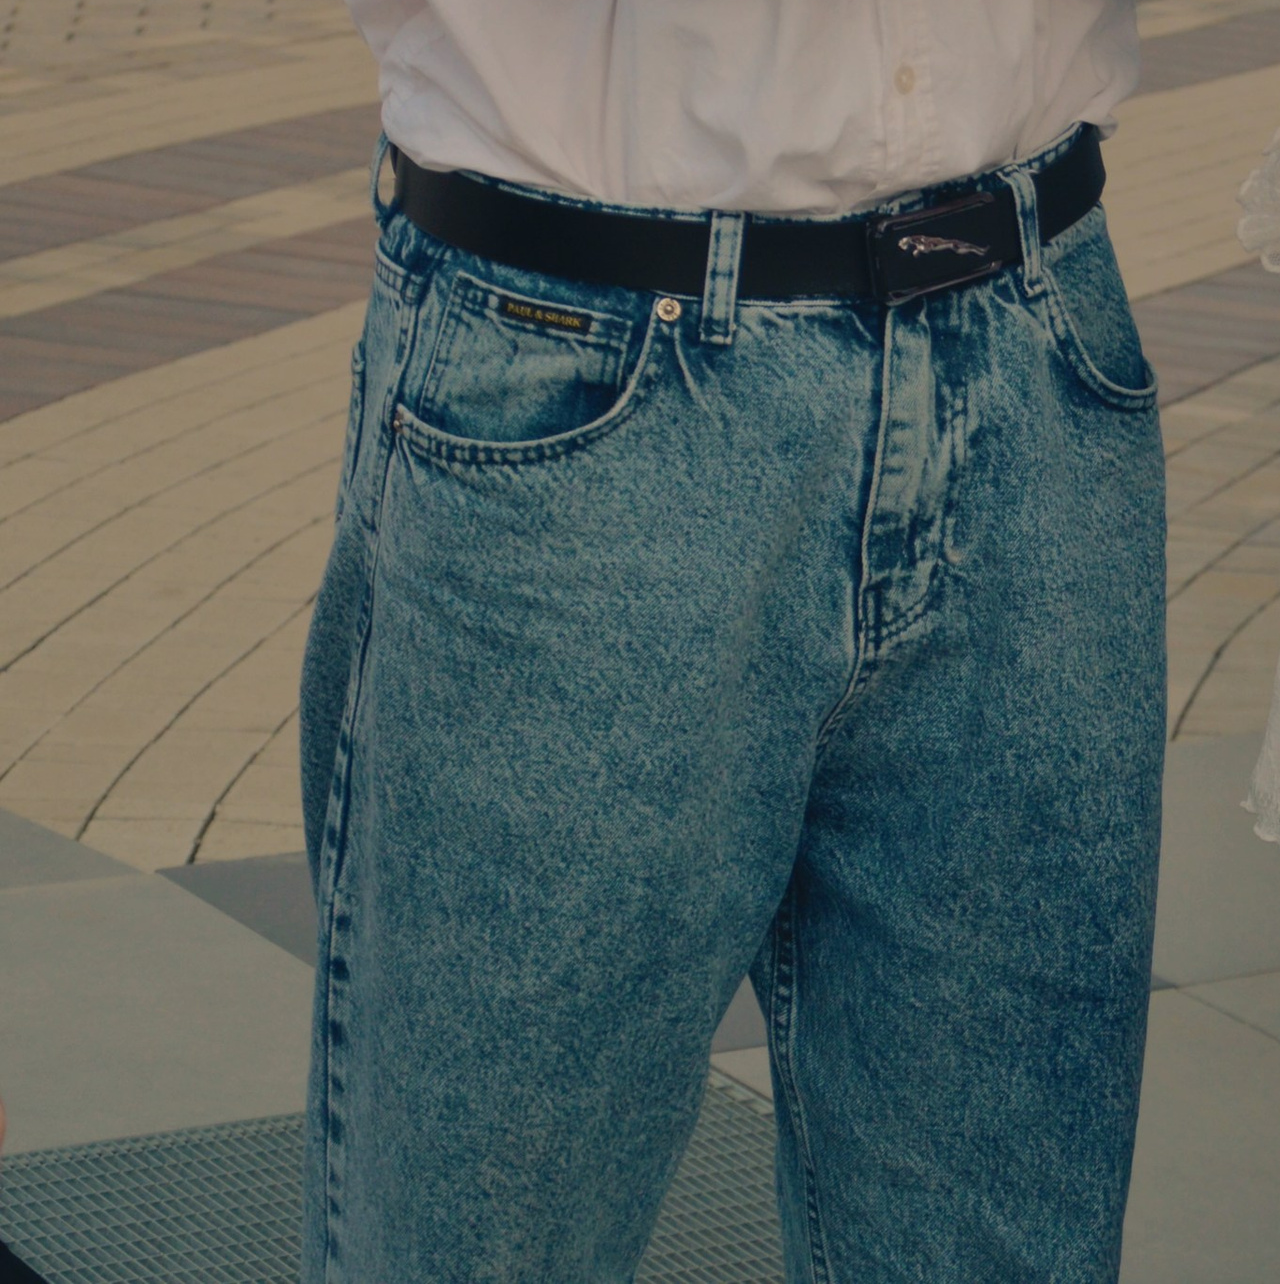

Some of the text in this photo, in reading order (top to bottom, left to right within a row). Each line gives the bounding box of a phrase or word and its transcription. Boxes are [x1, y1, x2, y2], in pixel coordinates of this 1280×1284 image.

[507, 301, 582, 328] PAUL & SHARK
